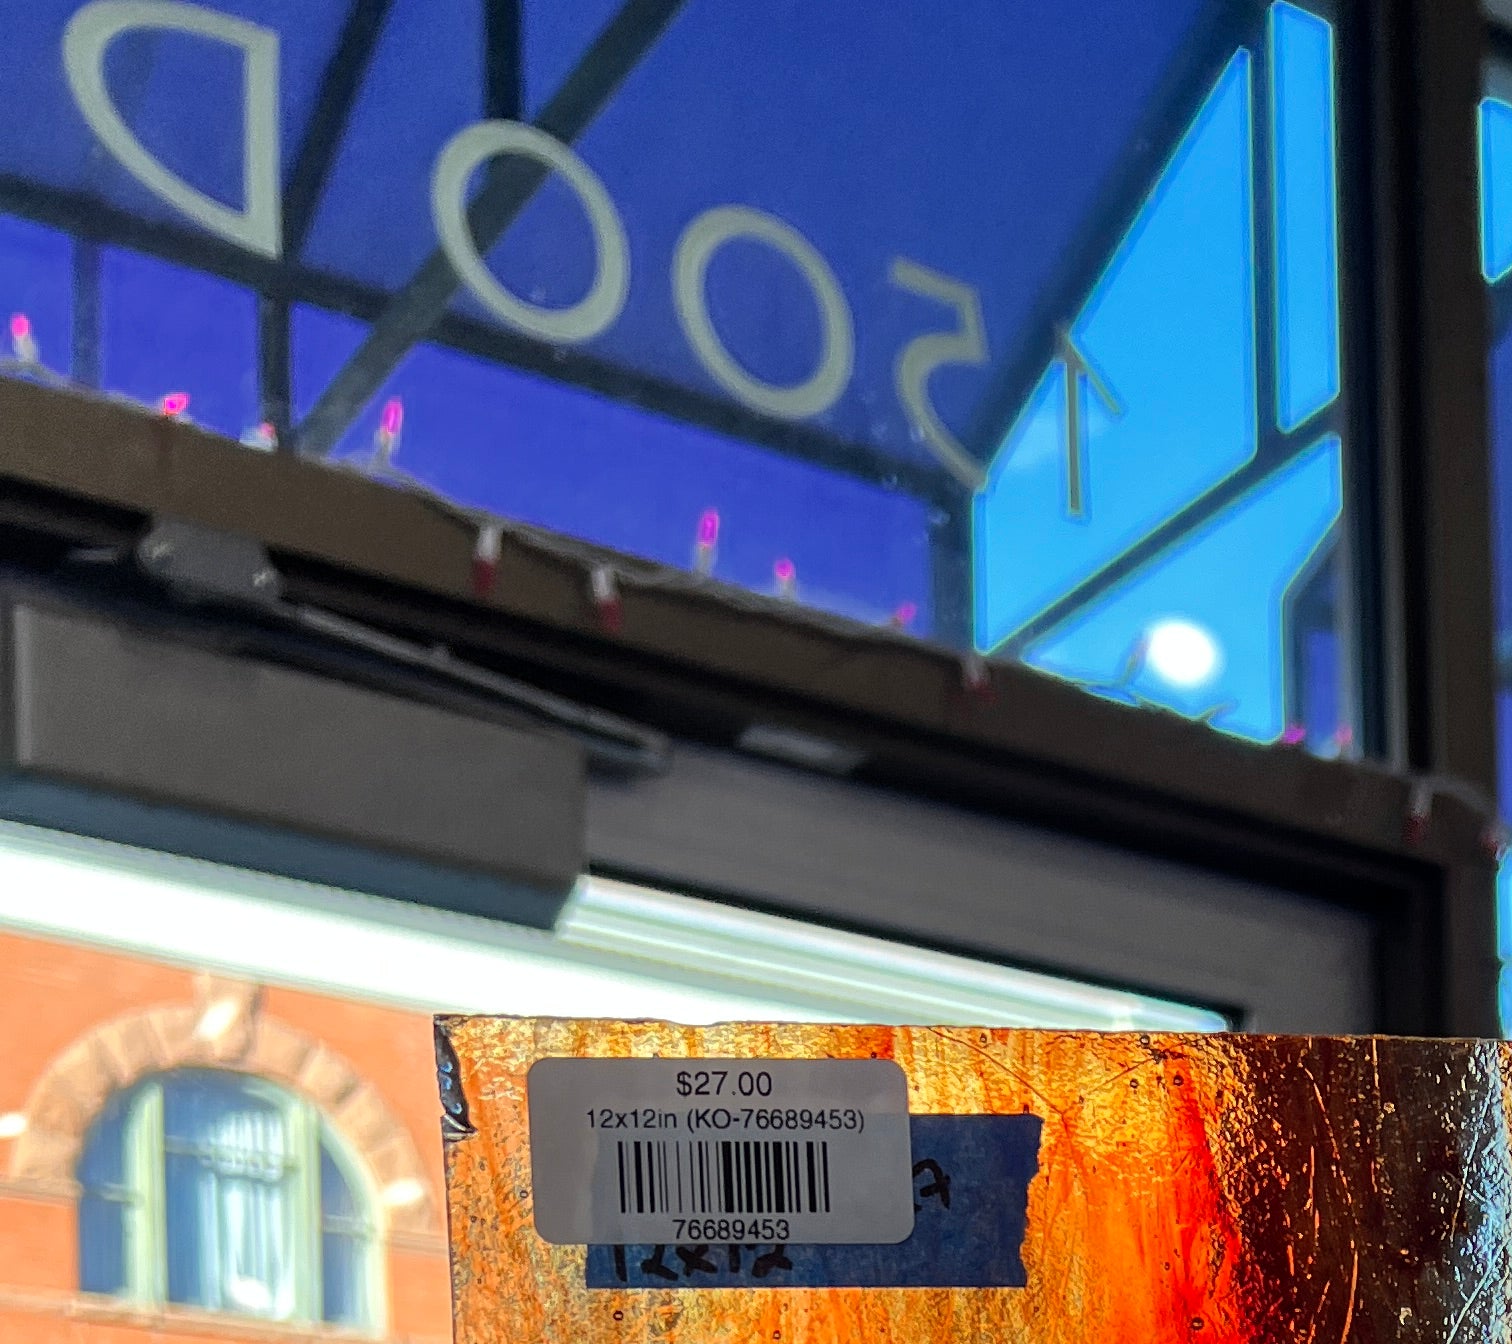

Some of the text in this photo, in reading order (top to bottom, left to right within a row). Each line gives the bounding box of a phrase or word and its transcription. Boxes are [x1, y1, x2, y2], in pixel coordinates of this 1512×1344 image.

[676, 1070, 773, 1097] $27.00
[586, 1107, 865, 1134] 12x12in (KO-76689453)
[672, 1218, 790, 1241] 76689453
